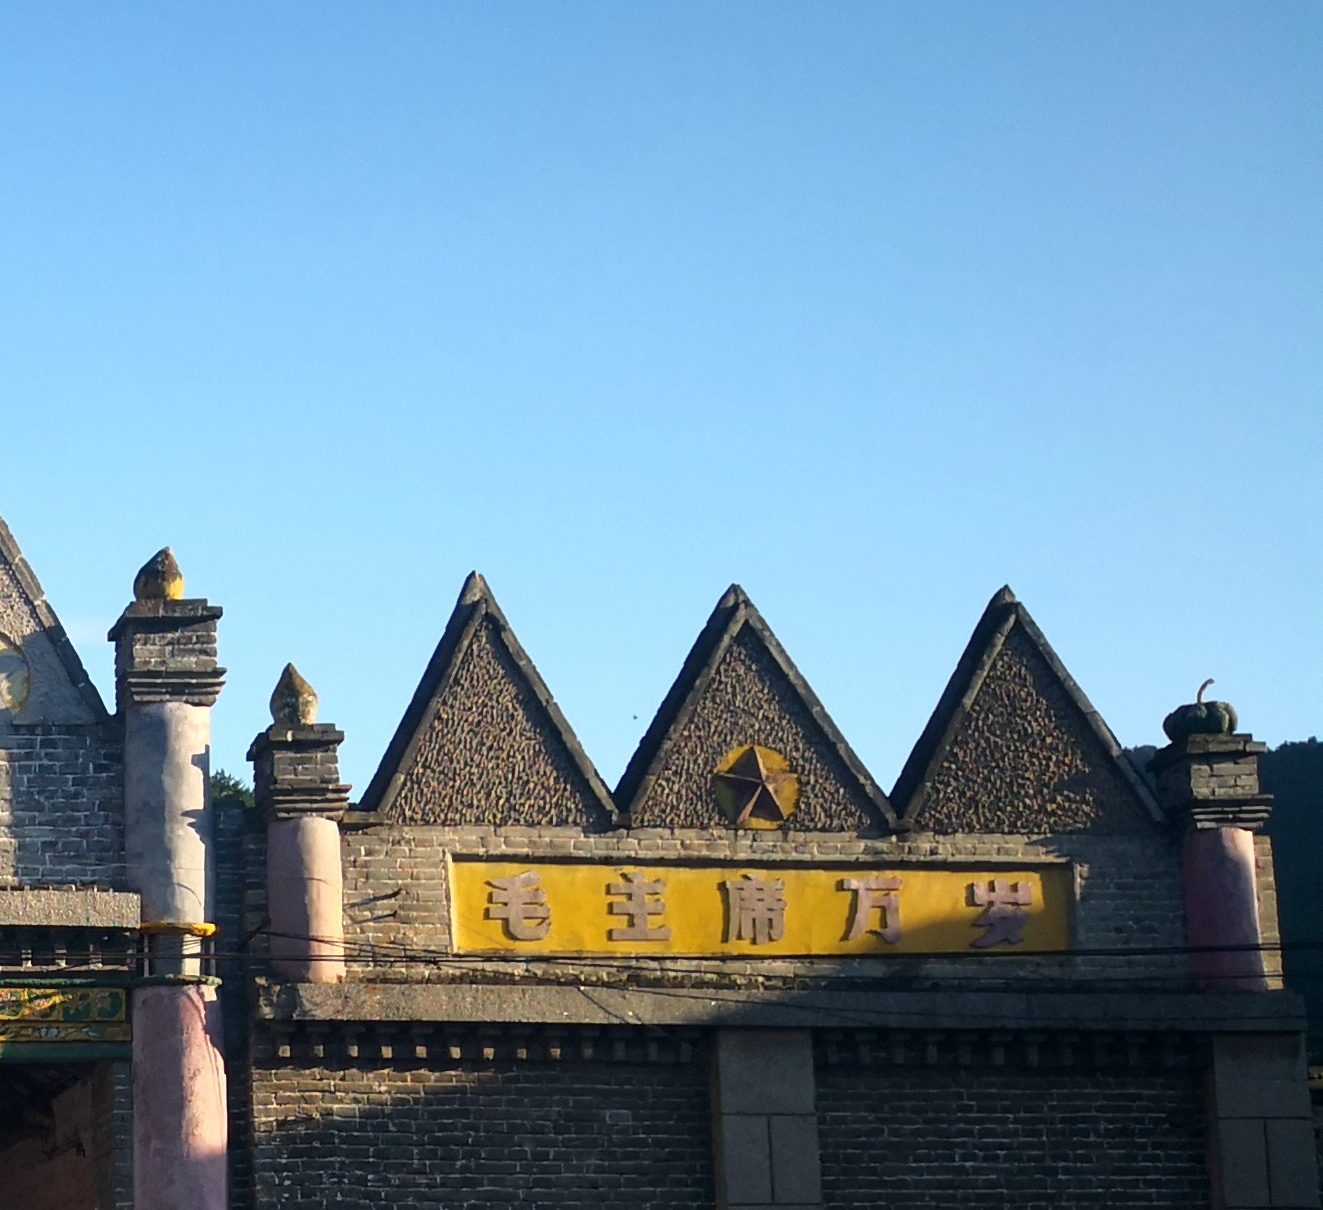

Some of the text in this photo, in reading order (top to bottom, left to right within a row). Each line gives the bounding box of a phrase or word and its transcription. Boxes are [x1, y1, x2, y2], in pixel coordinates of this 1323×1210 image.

[484, 870, 1033, 949] 毛主席万岁
